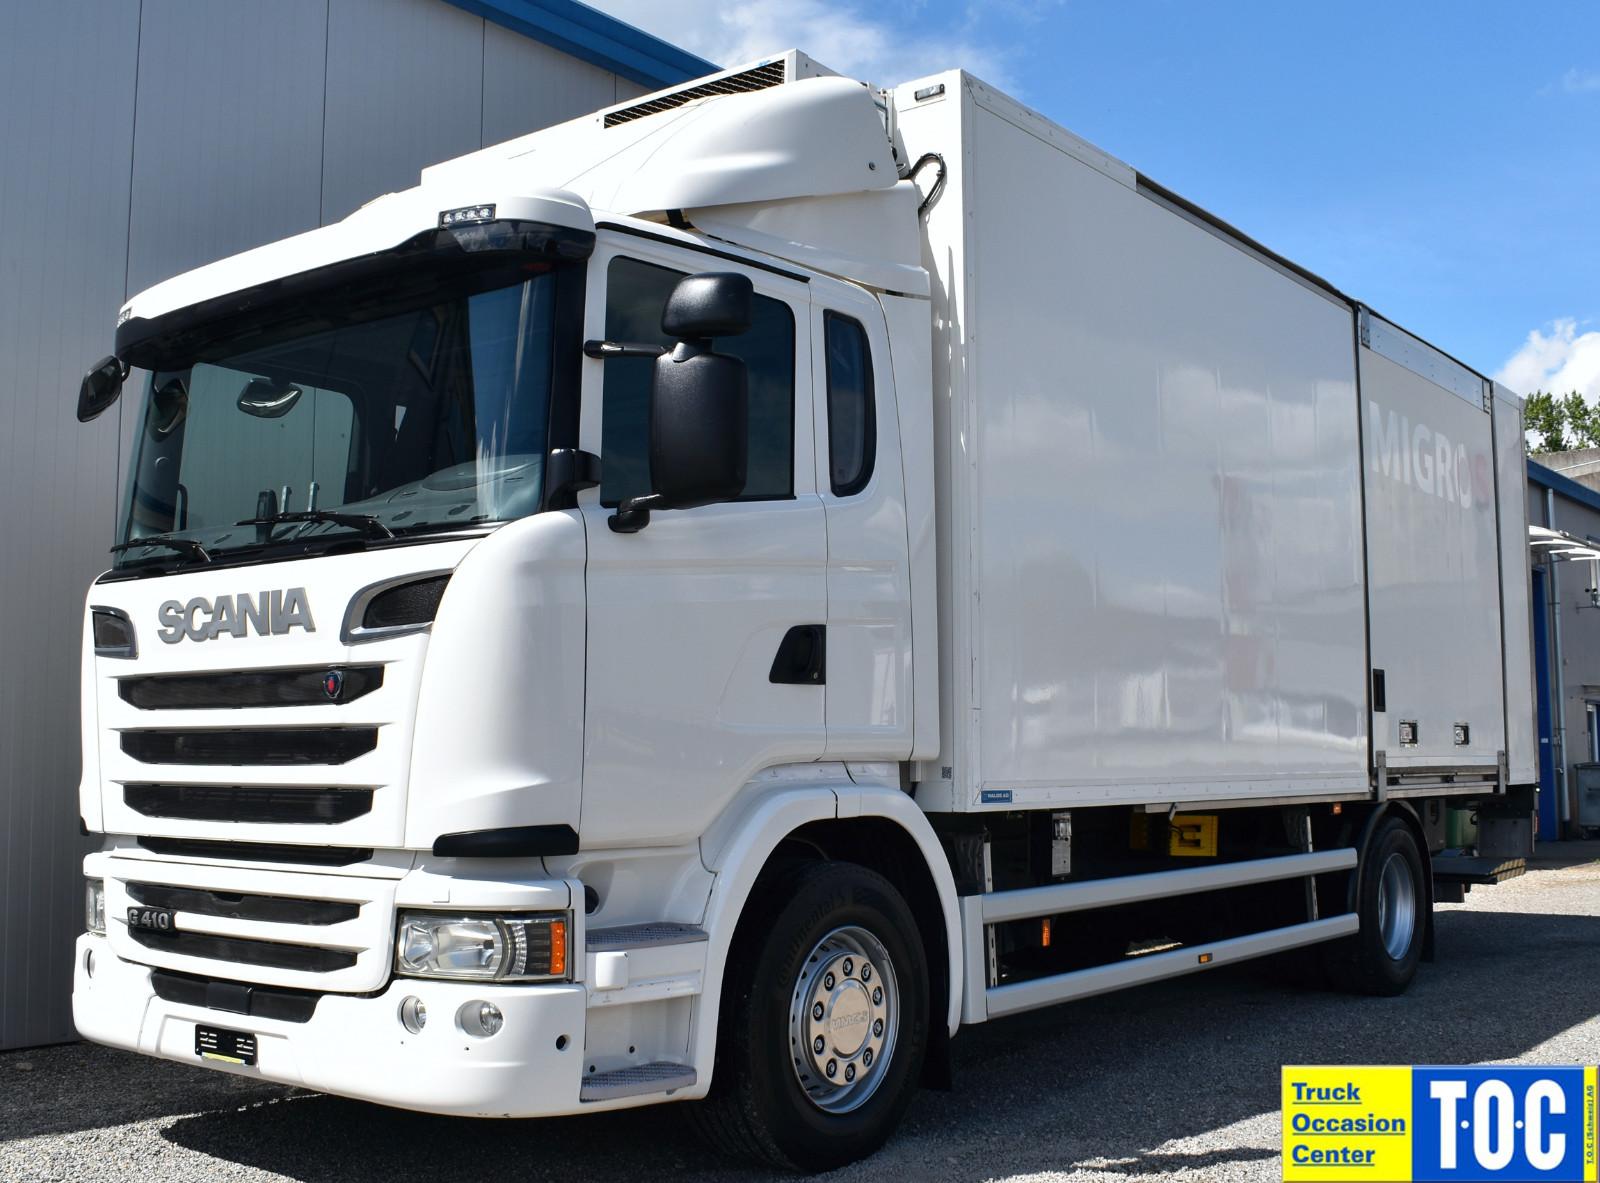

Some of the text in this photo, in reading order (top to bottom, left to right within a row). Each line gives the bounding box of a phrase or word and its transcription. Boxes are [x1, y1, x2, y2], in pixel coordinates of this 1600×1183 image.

[1369, 400, 1490, 513] MIGRO
[157, 587, 316, 644] SCANIA
[128, 909, 169, 929] G 410
